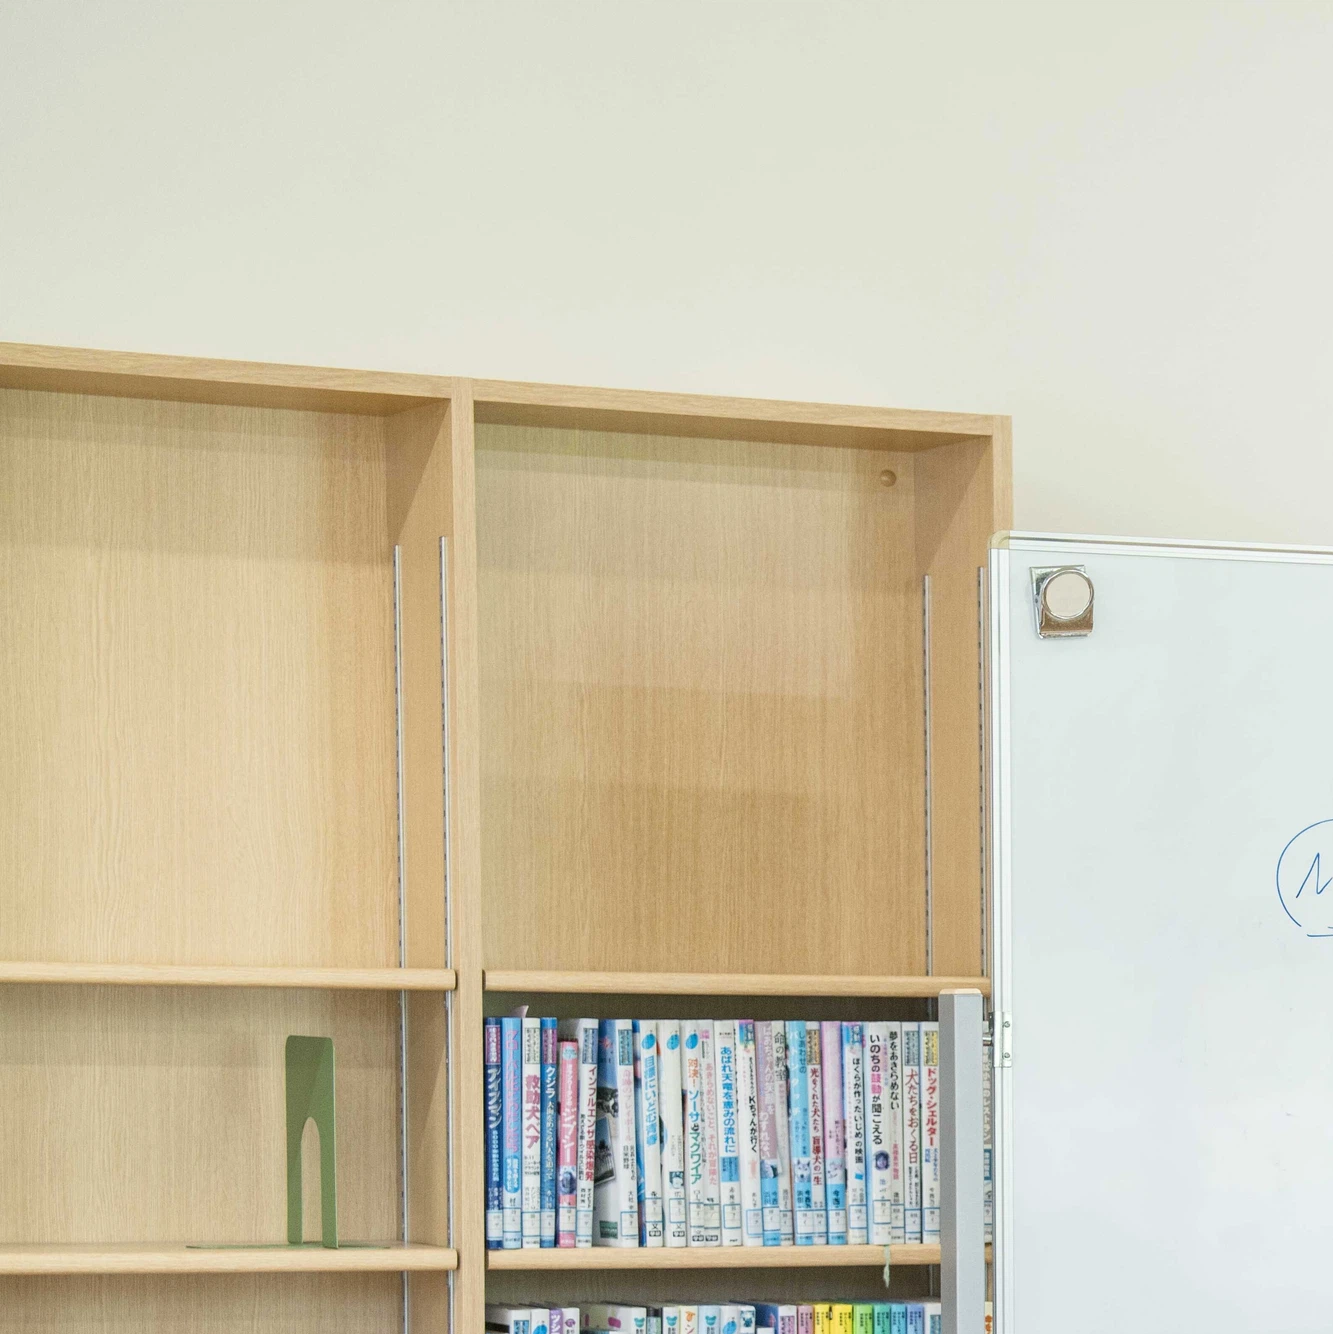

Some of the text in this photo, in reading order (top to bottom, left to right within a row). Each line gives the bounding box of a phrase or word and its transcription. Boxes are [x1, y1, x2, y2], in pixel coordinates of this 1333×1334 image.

[545, 1066, 556, 1099] クジラ
[644, 1055, 658, 1146] 目標にいどむ青春
[721, 1046, 736, 1153] あばれ天竜を恵みの流れに
[774, 1032, 787, 1081] 命の教室
[870, 1034, 882, 1145] いのちの鼓動が聞こえる
[889, 1031, 900, 1110] 夢をあきらめない
[525, 1075, 540, 1149] 救助犬ベア
[585, 1066, 598, 1181] インフルエンザ感染爆発
[810, 1067, 823, 1186] 光をくれた犬たち 盲導犬の一生
[905, 1069, 919, 1164] 犬たちをおくる日
[926, 1068, 938, 1146] ドッグ・シェルター
